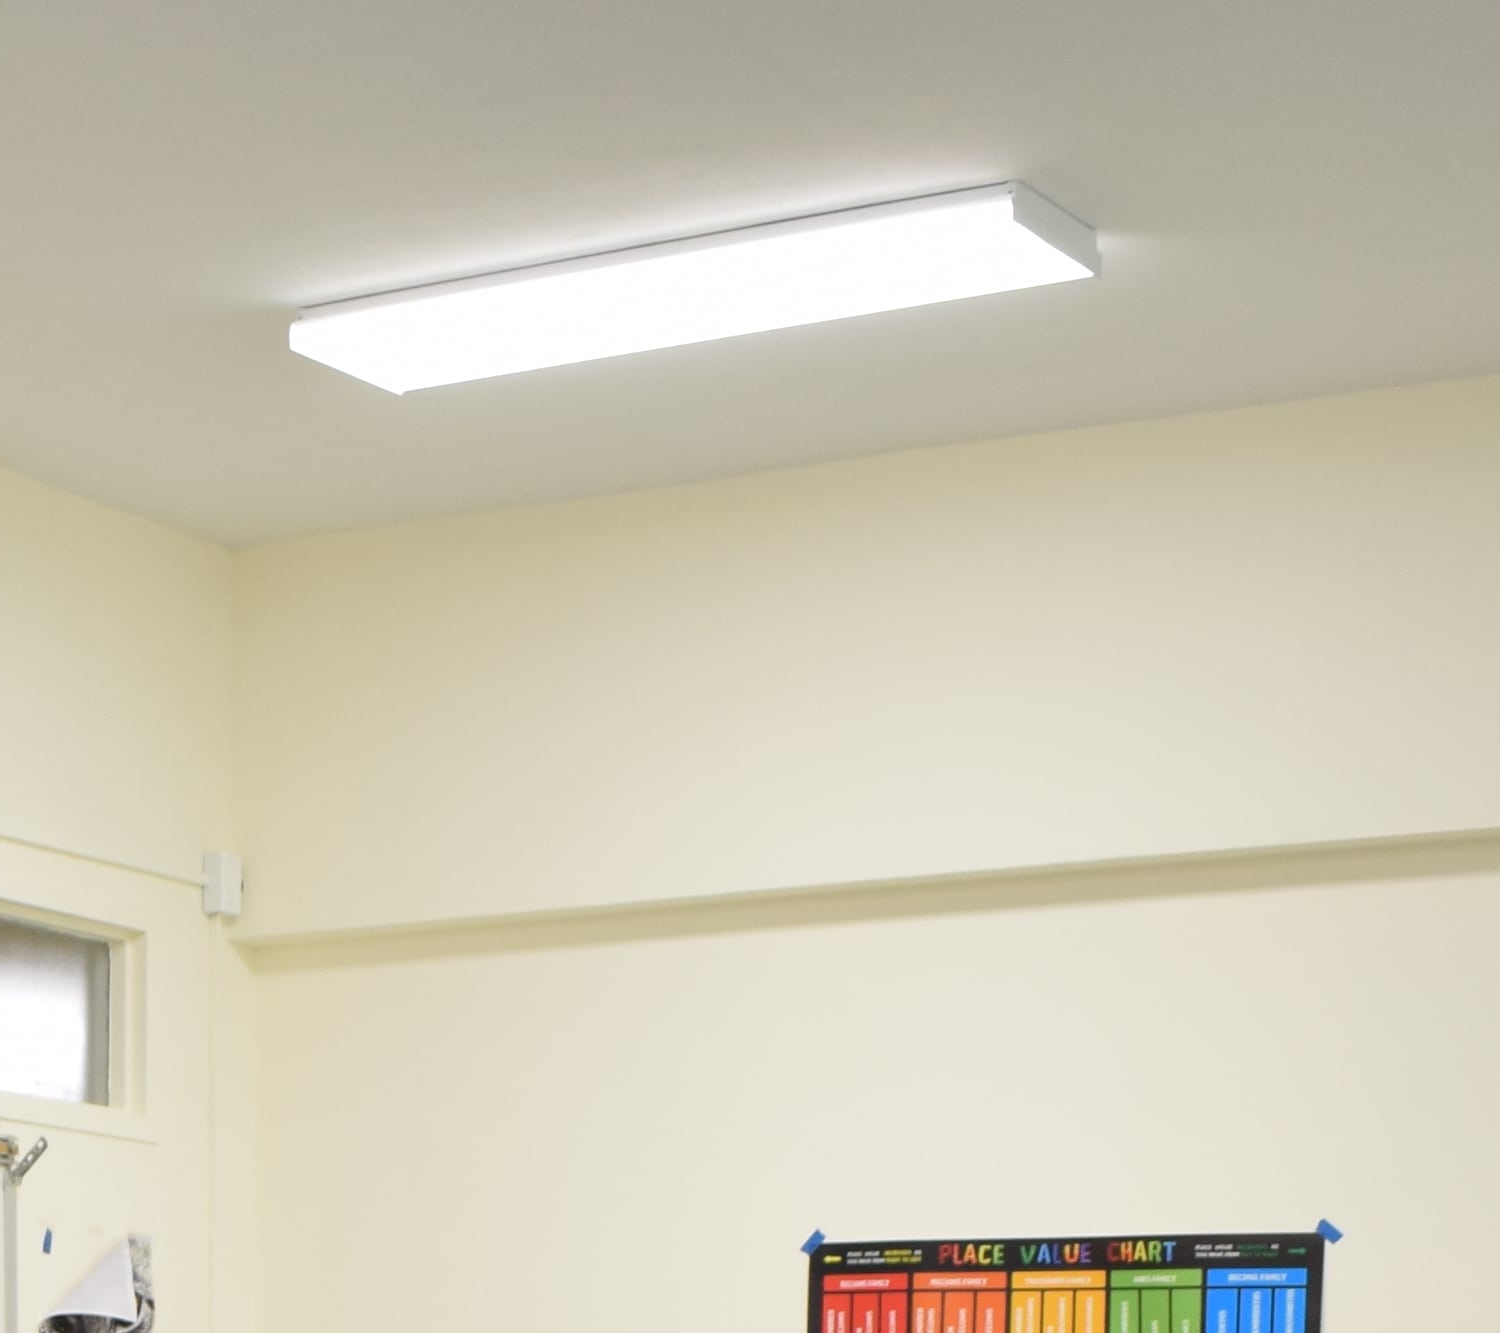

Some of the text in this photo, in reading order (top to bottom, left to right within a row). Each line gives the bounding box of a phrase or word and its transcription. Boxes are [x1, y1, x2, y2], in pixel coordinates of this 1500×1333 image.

[939, 1244, 1004, 1265] PLACE
[1020, 1241, 1091, 1264] VALUE
[1107, 1241, 1176, 1262] CHART
